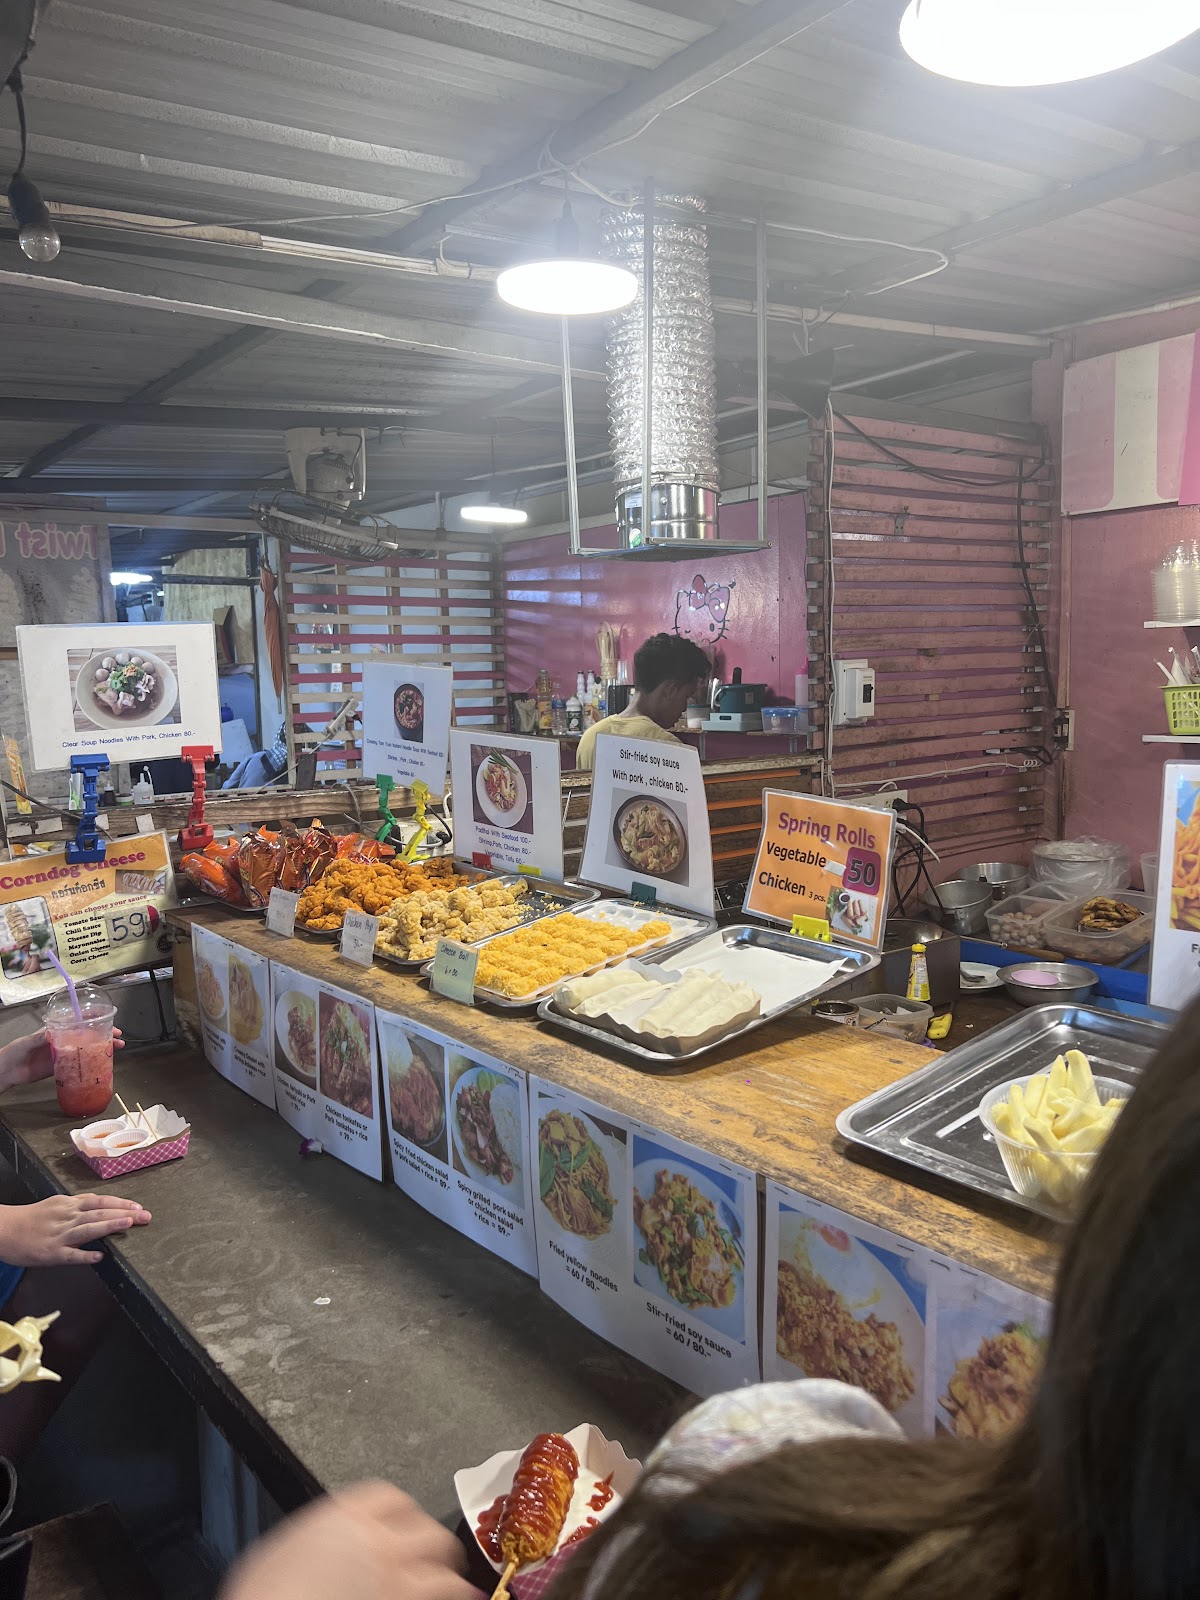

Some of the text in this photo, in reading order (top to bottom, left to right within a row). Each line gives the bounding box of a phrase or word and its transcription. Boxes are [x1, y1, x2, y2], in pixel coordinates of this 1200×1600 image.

[620, 749, 680, 769] Stir-fried soy sauce
[612, 769, 628, 780] With
[629, 774, 644, 784] pork
[649, 776, 674, 790] chicken
[502, 832, 518, 842] Seafood
[778, 812, 876, 849] Spring Rolls
[504, 843, 520, 854] Chicken
[767, 841, 826, 868] Vegetable
[0, 864, 81, 890] Corndog
[846, 859, 876, 887] 50
[758, 872, 806, 896] Chicken
[84, 904, 108, 913] choose
[109, 900, 127, 908] your
[63, 918, 88, 928] Tomato
[82, 924, 101, 932] Sauce
[112, 912, 146, 941] 59
[67, 934, 89, 943] Cheese
[70, 951, 109, 965] Corn Cheese
[326, 1105, 342, 1118] Chicken
[424, 1171, 434, 1181] rice
[435, 1168, 448, 1180] salad
[458, 1180, 523, 1225] Spicy grilled pork salad
[475, 1202, 497, 1220] chicken
[498, 1216, 513, 1230] salad
[479, 1214, 490, 1225] rice
[549, 1240, 618, 1292] Fried yellow noodles
[572, 1268, 580, 1280] 60
[674, 1331, 684, 1343] 60
[688, 1328, 703, 1343] soy
[704, 1338, 732, 1358] sauce
